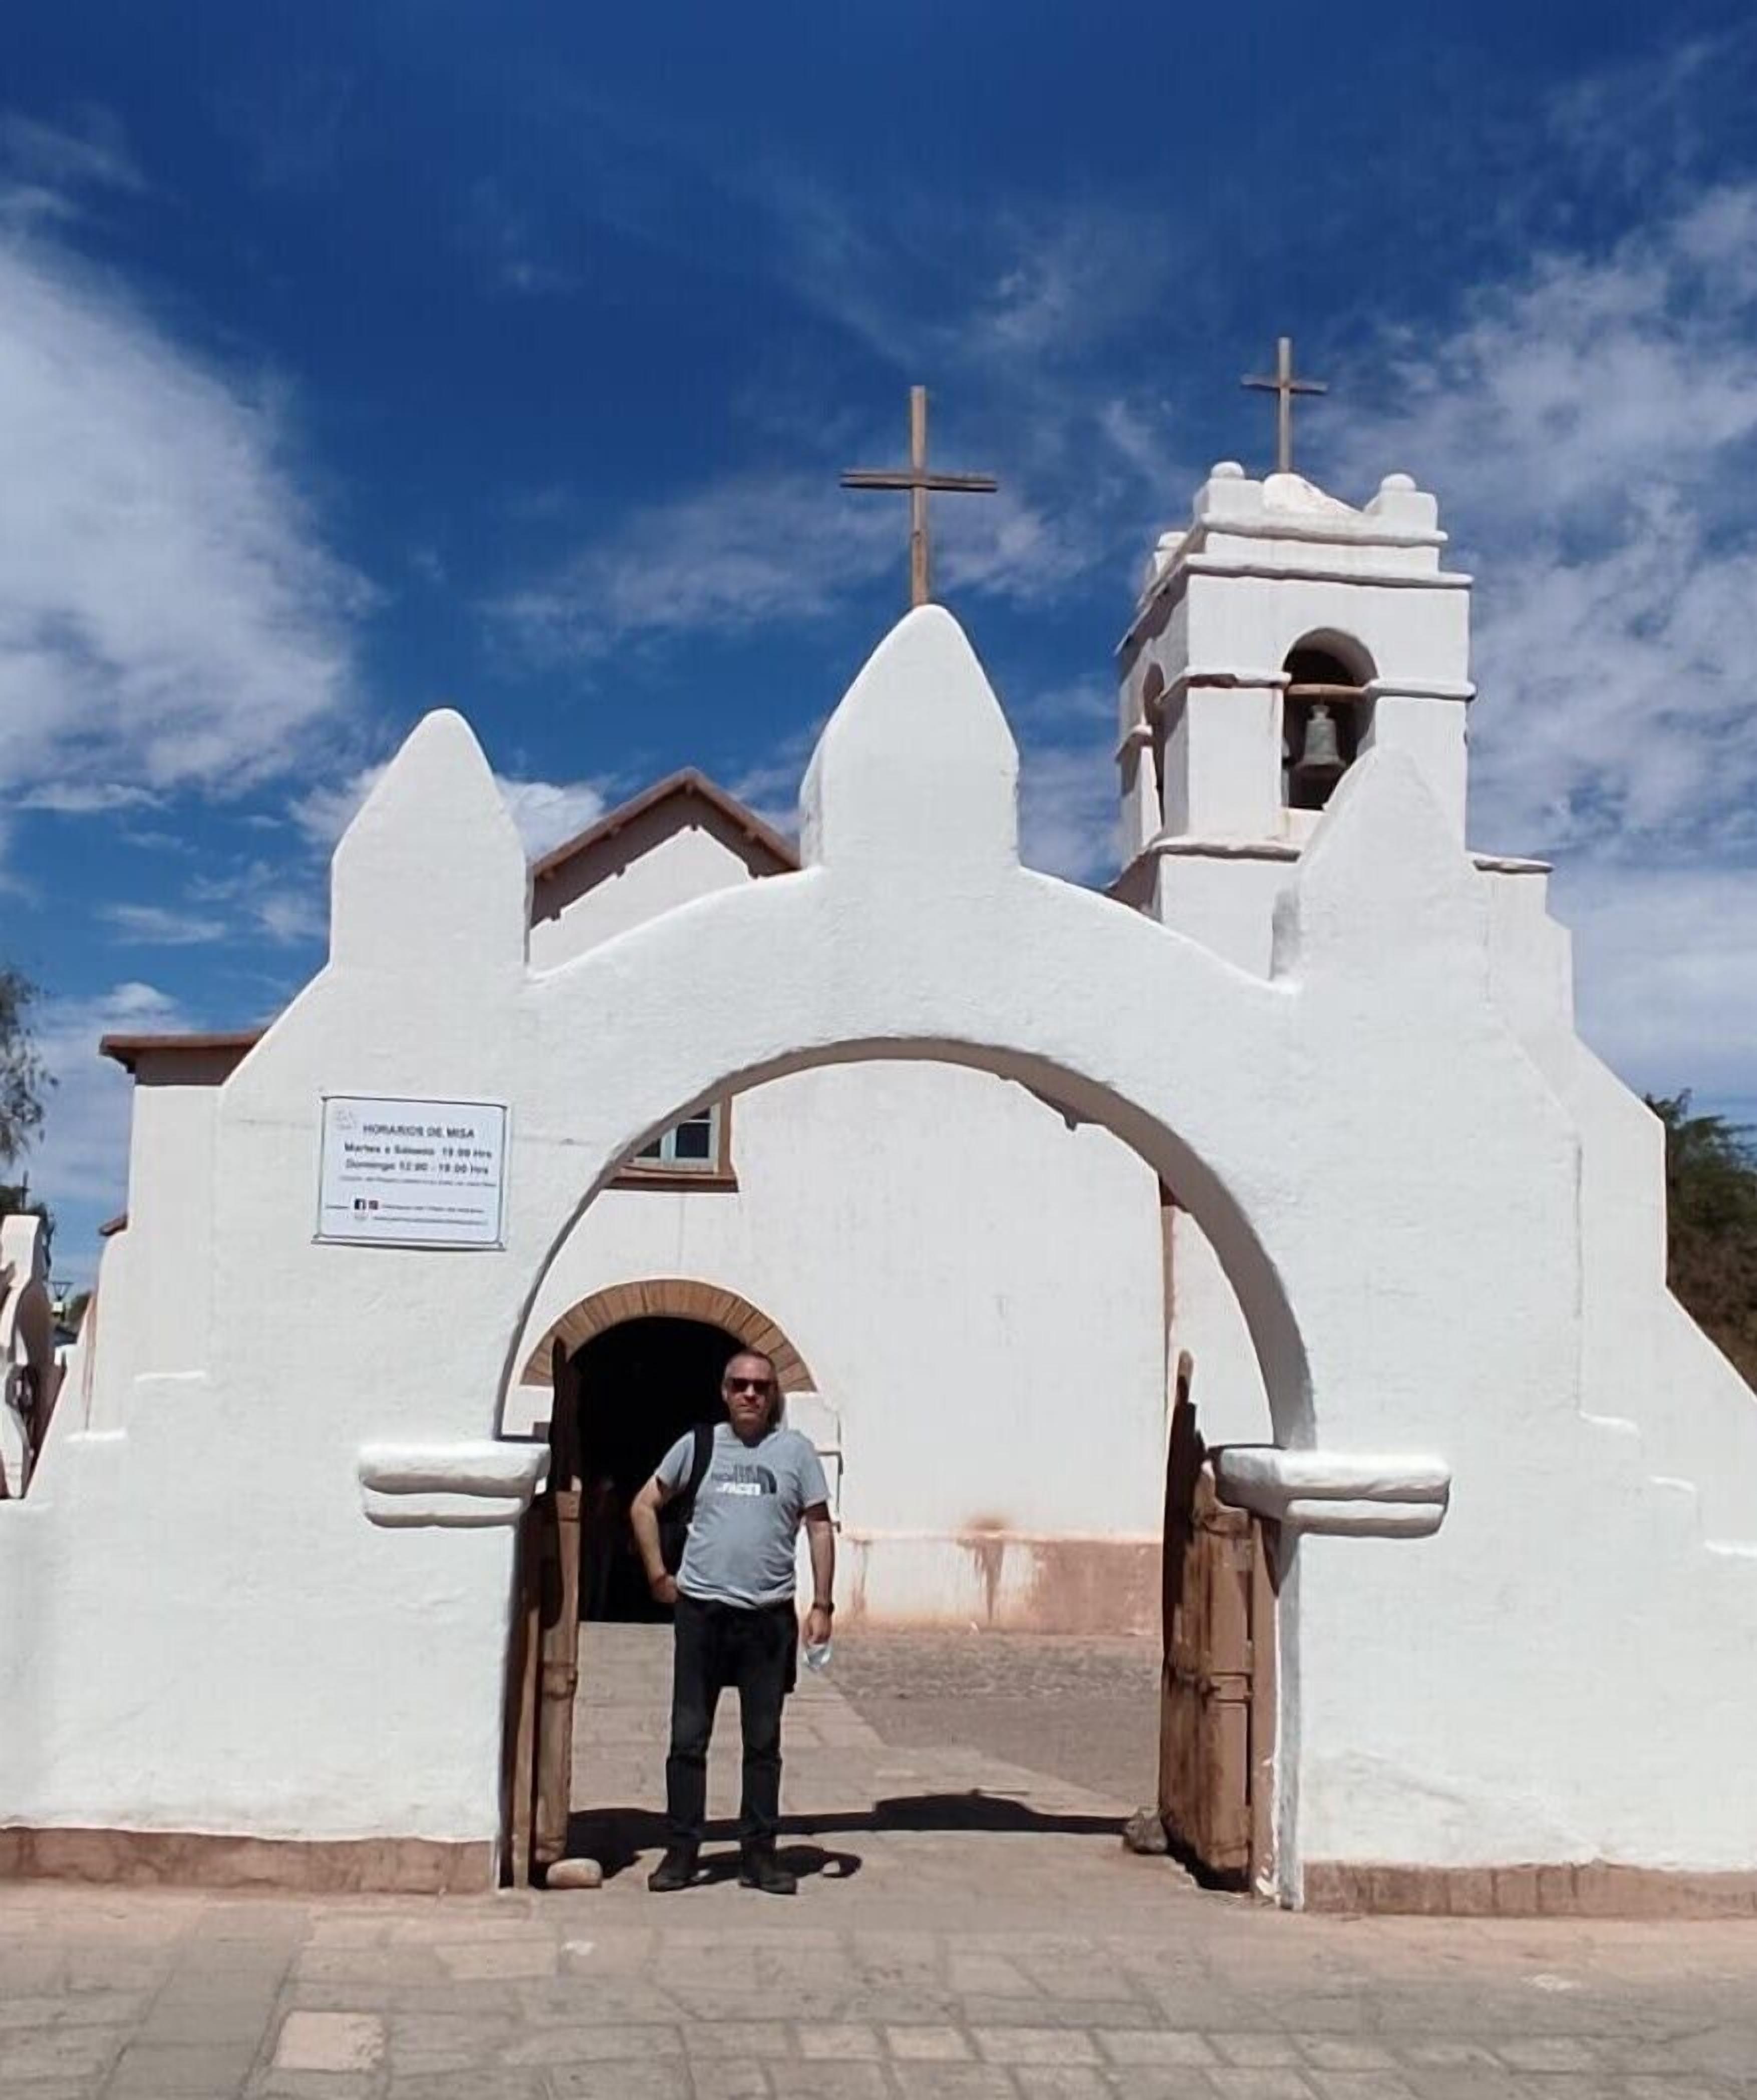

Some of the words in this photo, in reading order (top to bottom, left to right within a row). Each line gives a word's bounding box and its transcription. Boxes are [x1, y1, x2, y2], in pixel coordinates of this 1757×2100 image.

[363, 1124, 423, 1136] HORARIOS
[427, 1126, 442, 1138] DE
[447, 1128, 475, 1139] MISA
